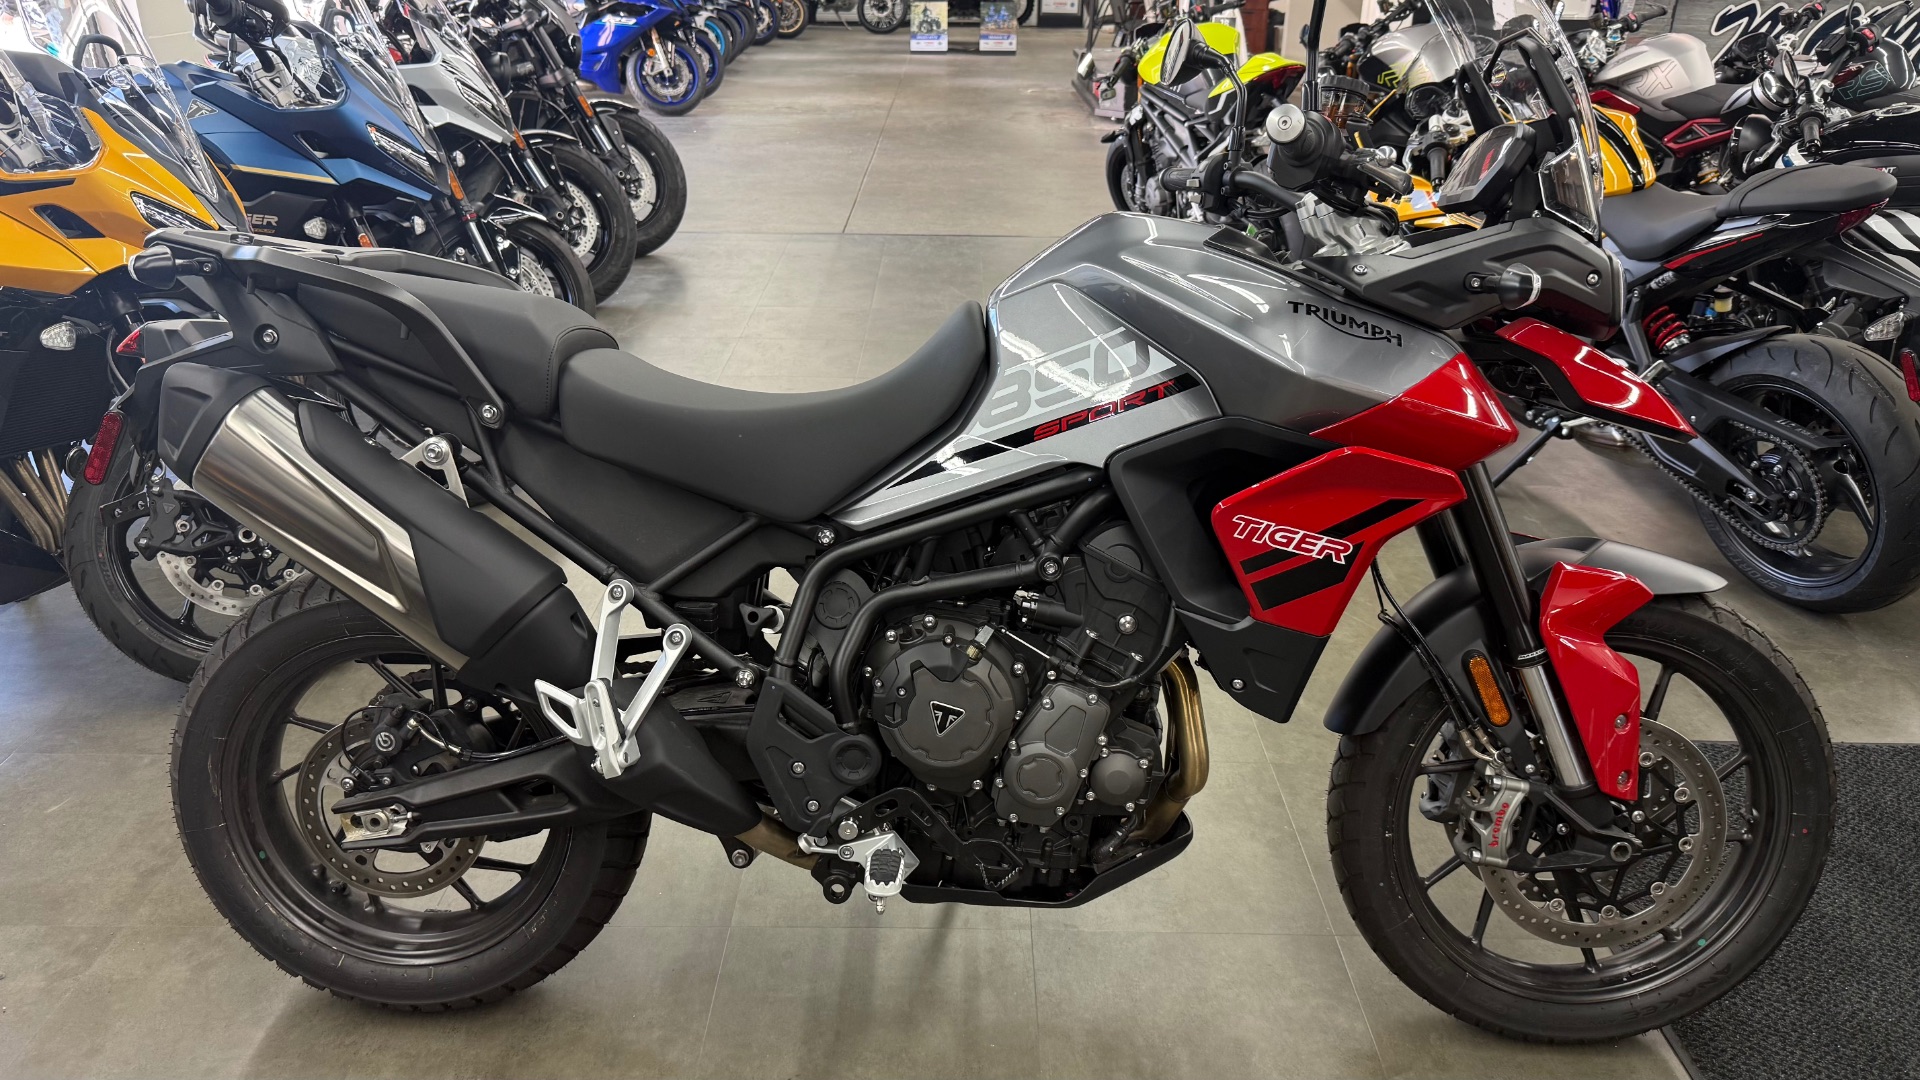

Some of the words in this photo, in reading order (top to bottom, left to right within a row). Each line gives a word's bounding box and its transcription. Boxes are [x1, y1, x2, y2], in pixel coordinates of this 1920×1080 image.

[1617, 60, 1677, 97] RX
[1285, 300, 1404, 348] TRIUMPH
[1033, 379, 1176, 442] SPORT
[1232, 514, 1354, 565] TIGER
[1488, 802, 1510, 848] brembo
